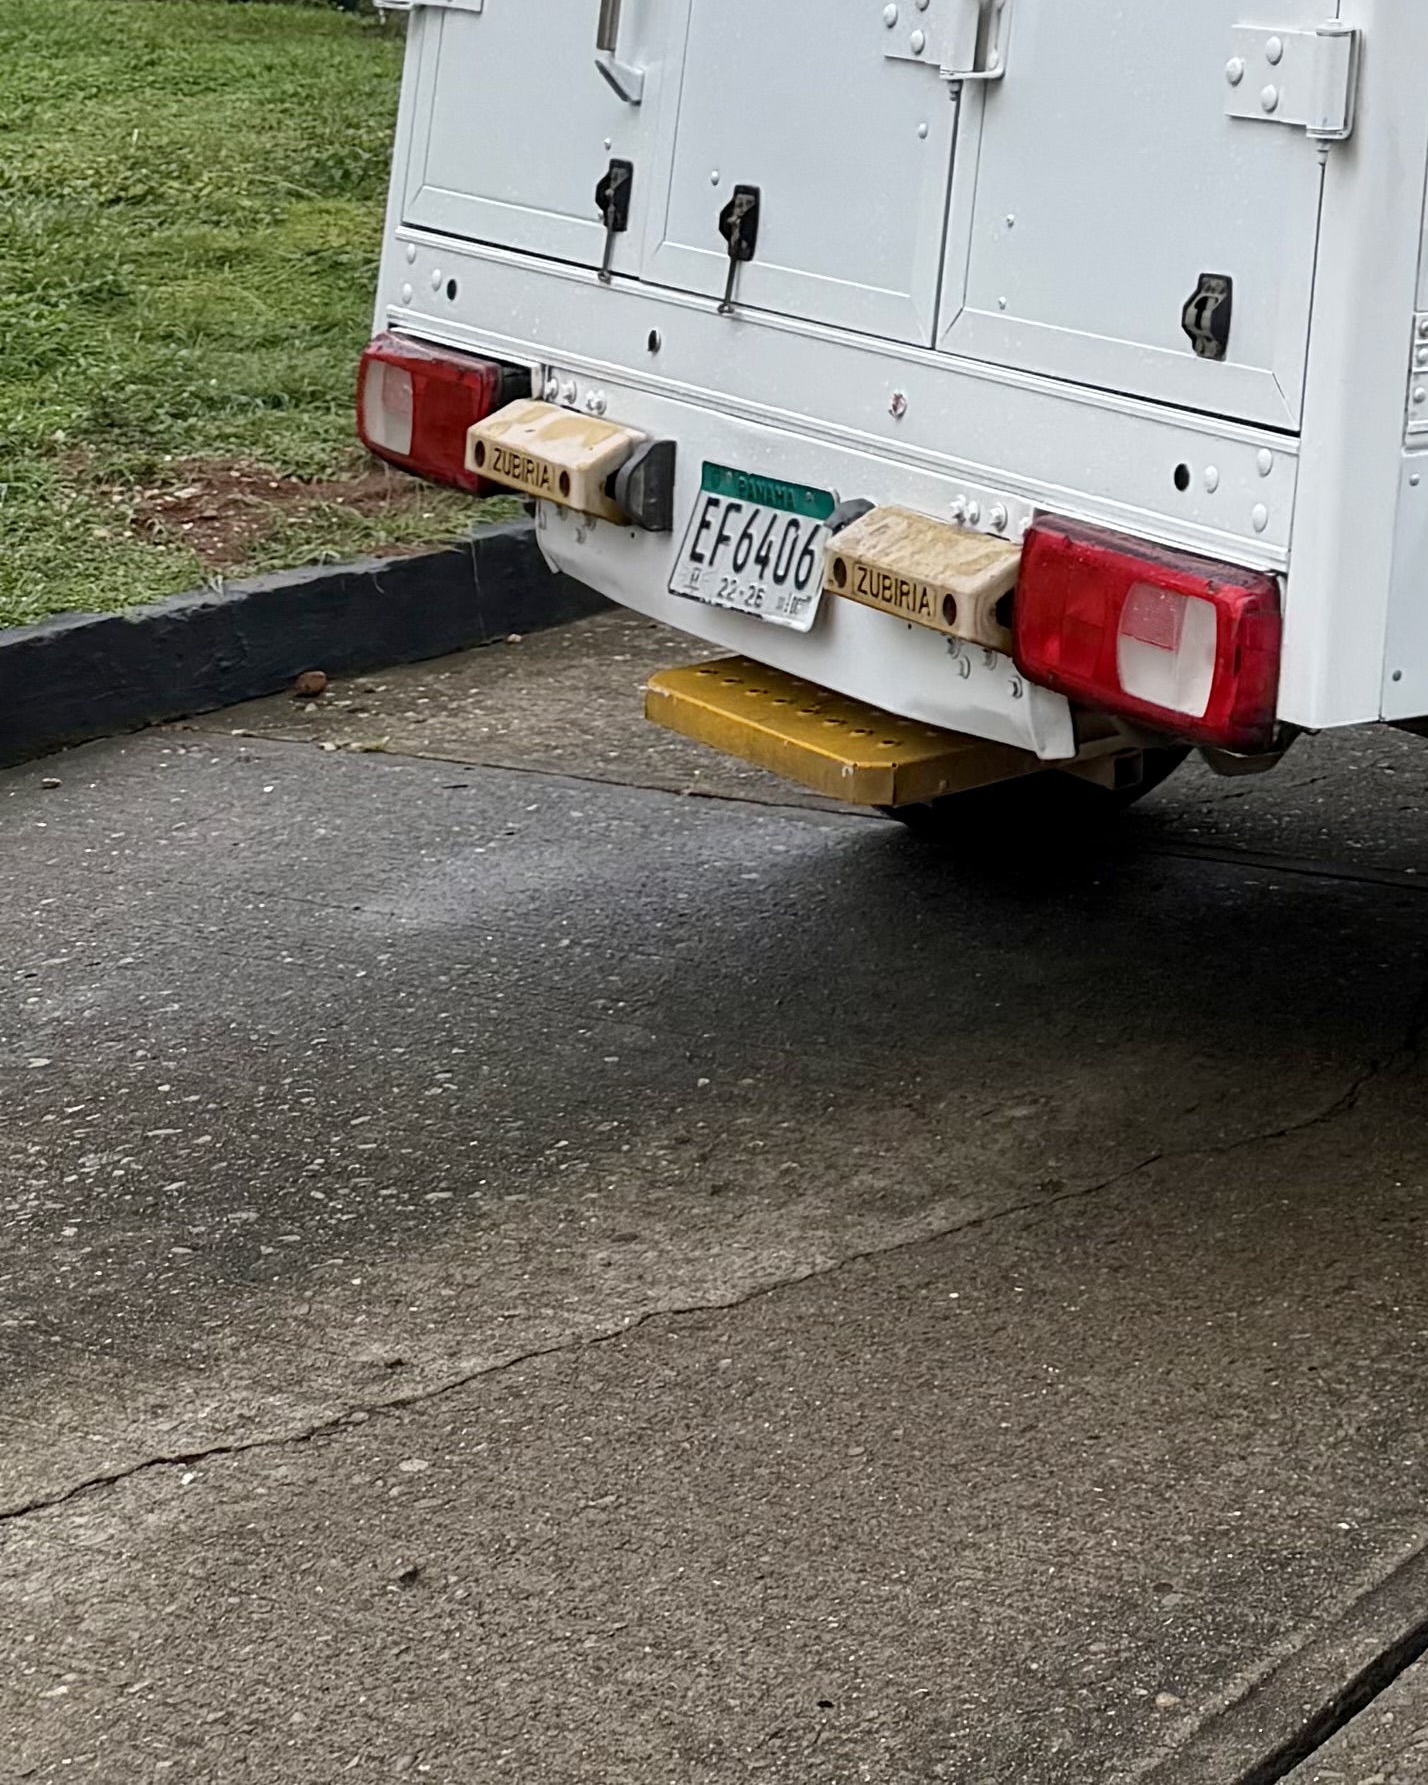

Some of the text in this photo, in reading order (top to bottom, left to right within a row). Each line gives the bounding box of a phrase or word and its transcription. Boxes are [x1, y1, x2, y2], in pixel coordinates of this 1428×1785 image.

[493, 447, 550, 491] ZUBIRIA
[690, 496, 821, 591] EF6406
[856, 567, 931, 617] ZUBIRIA
